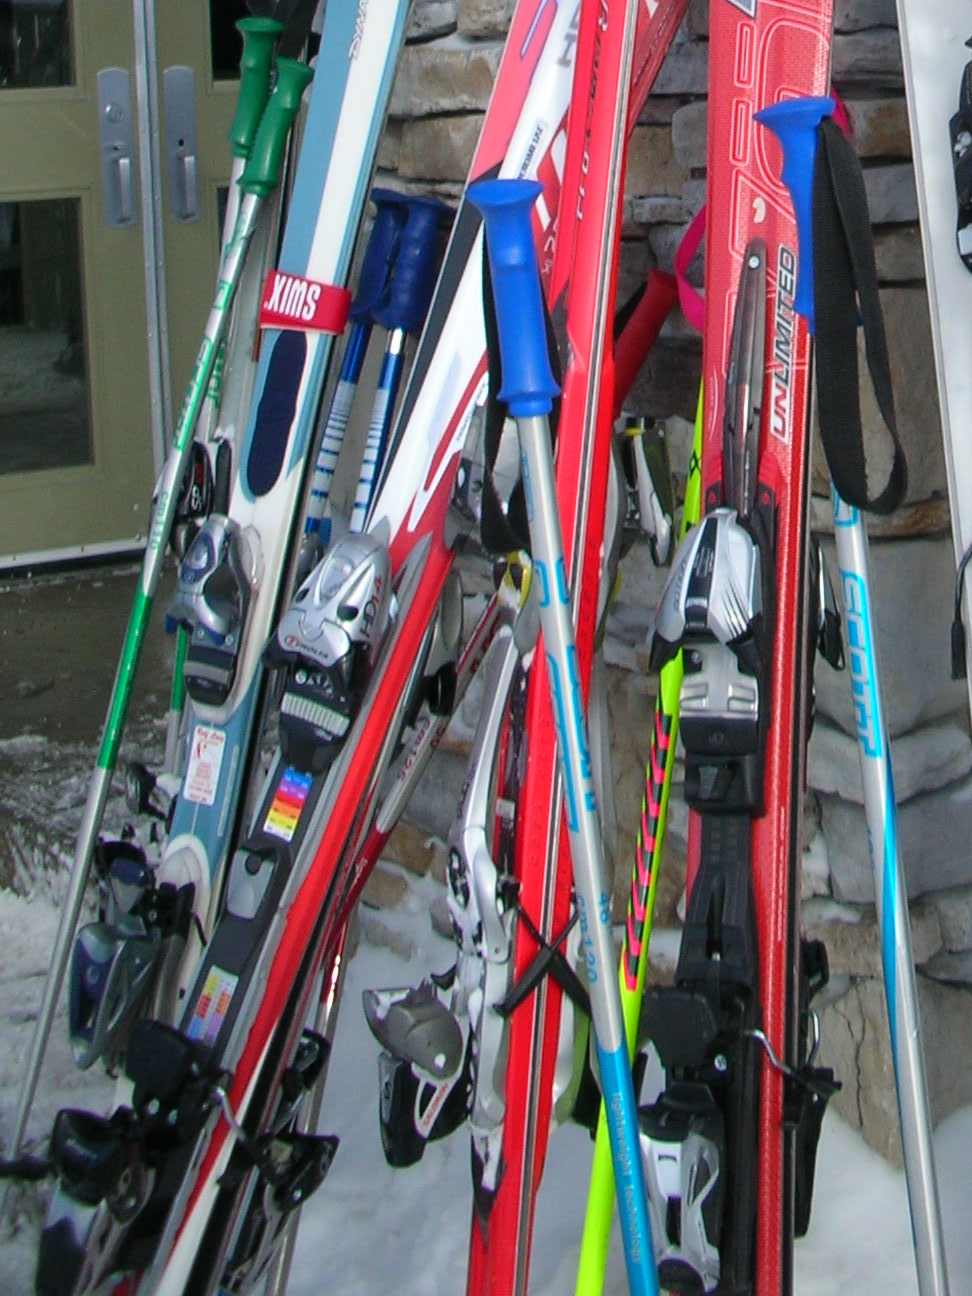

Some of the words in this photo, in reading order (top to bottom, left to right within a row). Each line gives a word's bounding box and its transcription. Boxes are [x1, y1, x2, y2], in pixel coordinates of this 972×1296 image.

[267, 273, 321, 321] SWIX
[769, 243, 797, 445] UNLIMITED
[611, 1092, 633, 1177] lightweight
[625, 1185, 643, 1266] technology
